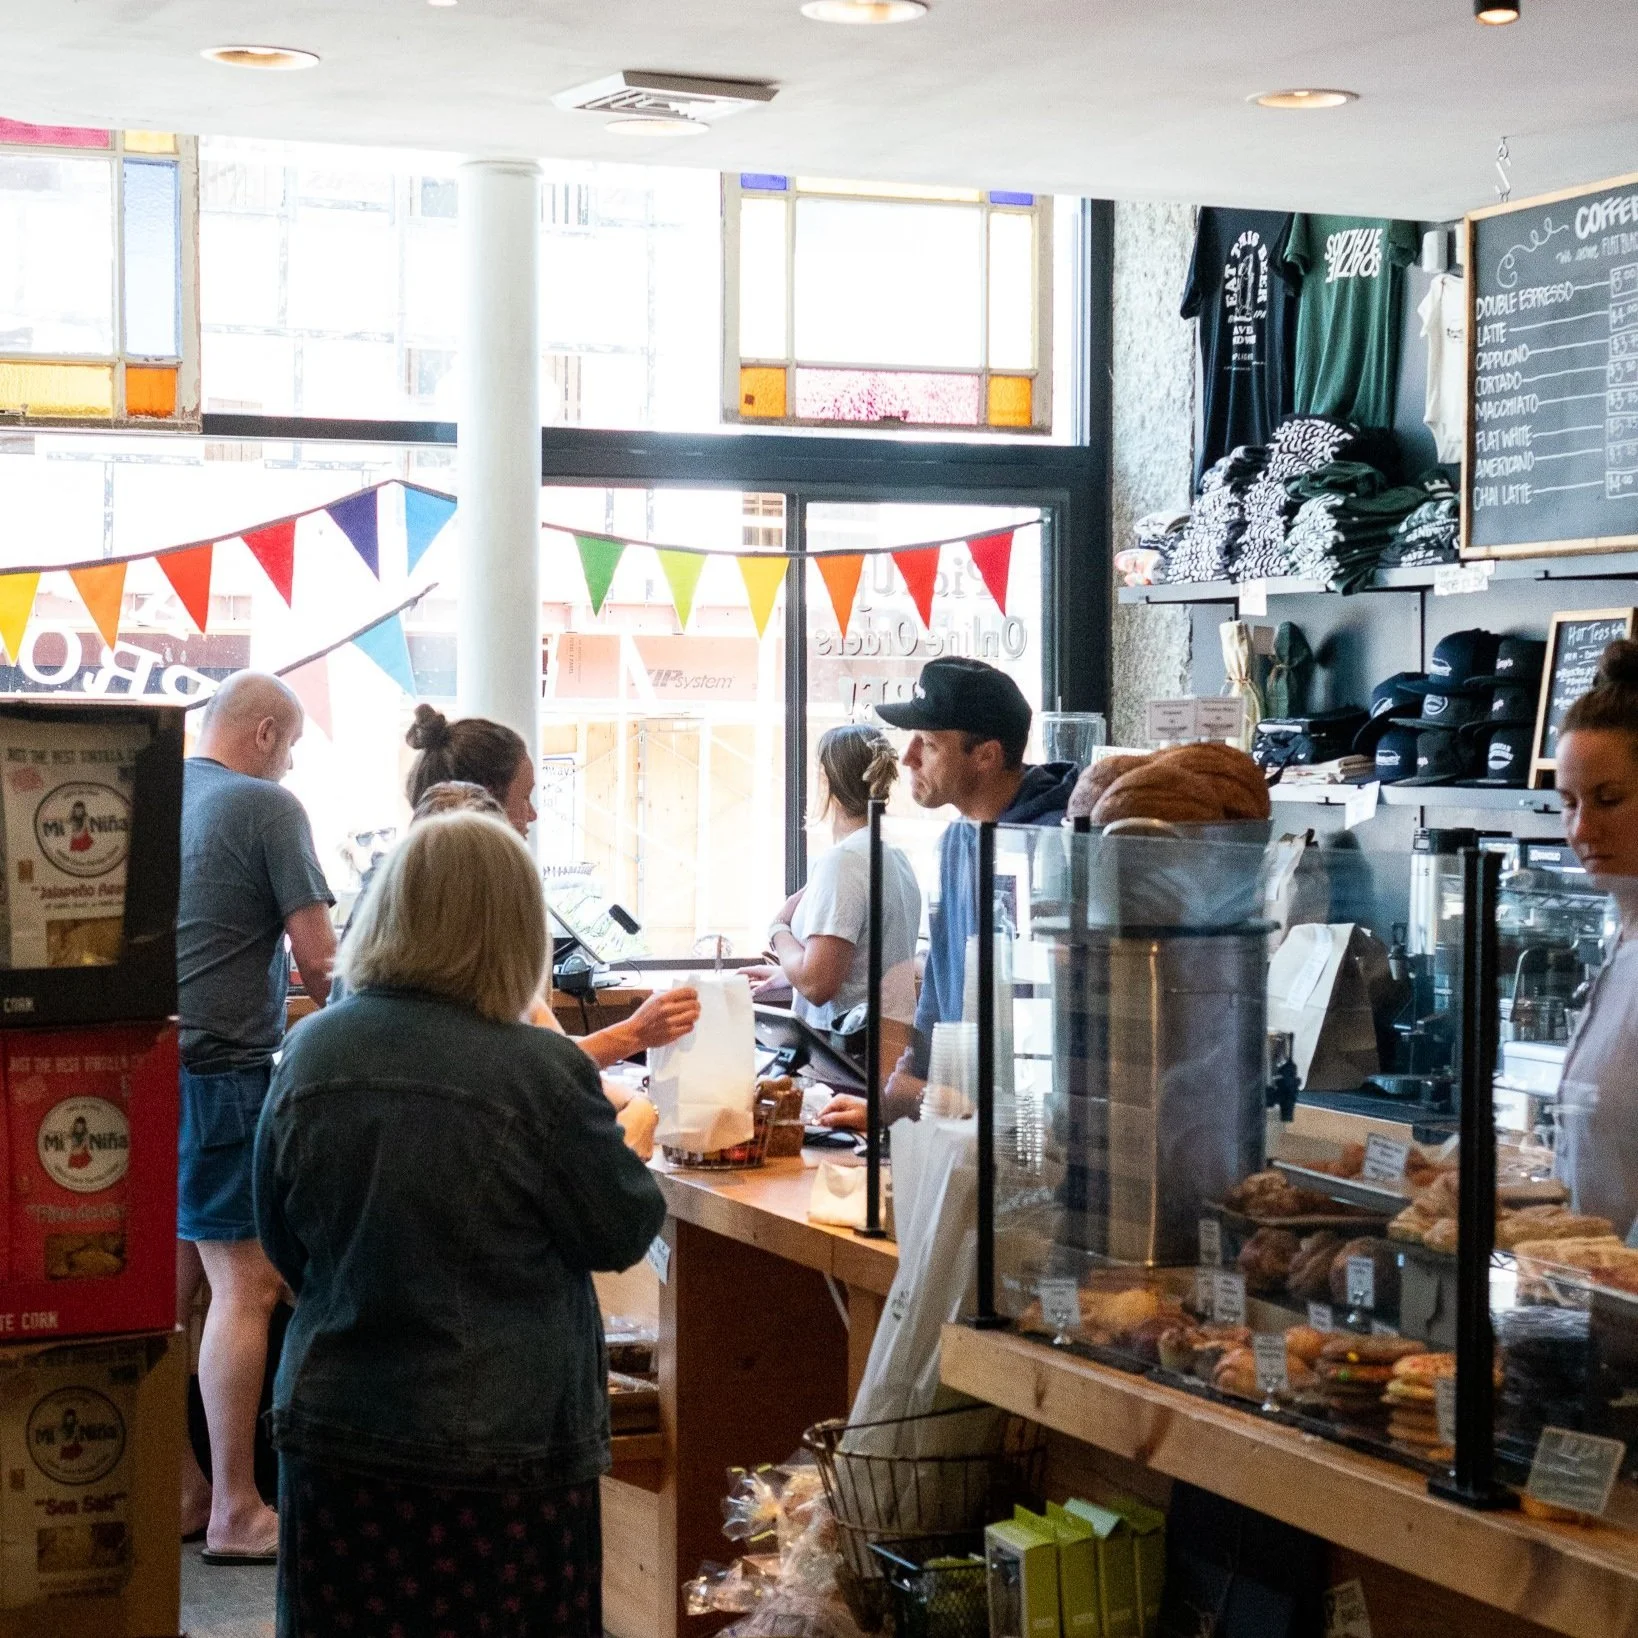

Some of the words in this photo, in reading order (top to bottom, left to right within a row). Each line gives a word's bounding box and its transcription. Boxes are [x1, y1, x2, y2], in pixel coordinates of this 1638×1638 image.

[1231, 231, 1260, 259] THIS
[1324, 228, 1383, 261] SOUTHIE
[1476, 292, 1517, 321] DOUBLE
[1518, 281, 1574, 310] ESPRESSO
[1477, 322, 1506, 347] LATTE
[1475, 371, 1523, 396] CORTADO
[1475, 393, 1539, 422] MACCHIATO
[1475, 429, 1502, 452] FLAT
[1502, 424, 1534, 448] WHITE
[1475, 451, 1535, 479] AMERICANO
[1473, 486, 1499, 511] CHAI
[1502, 482, 1533, 505] LATTE
[43, 820, 65, 837] Mi
[89, 814, 129, 833] Niña
[44, 1132, 65, 1151] Mi
[88, 1132, 129, 1151] Niña
[21, 1311, 59, 1330] CORN
[35, 1427, 55, 1446] Mi
